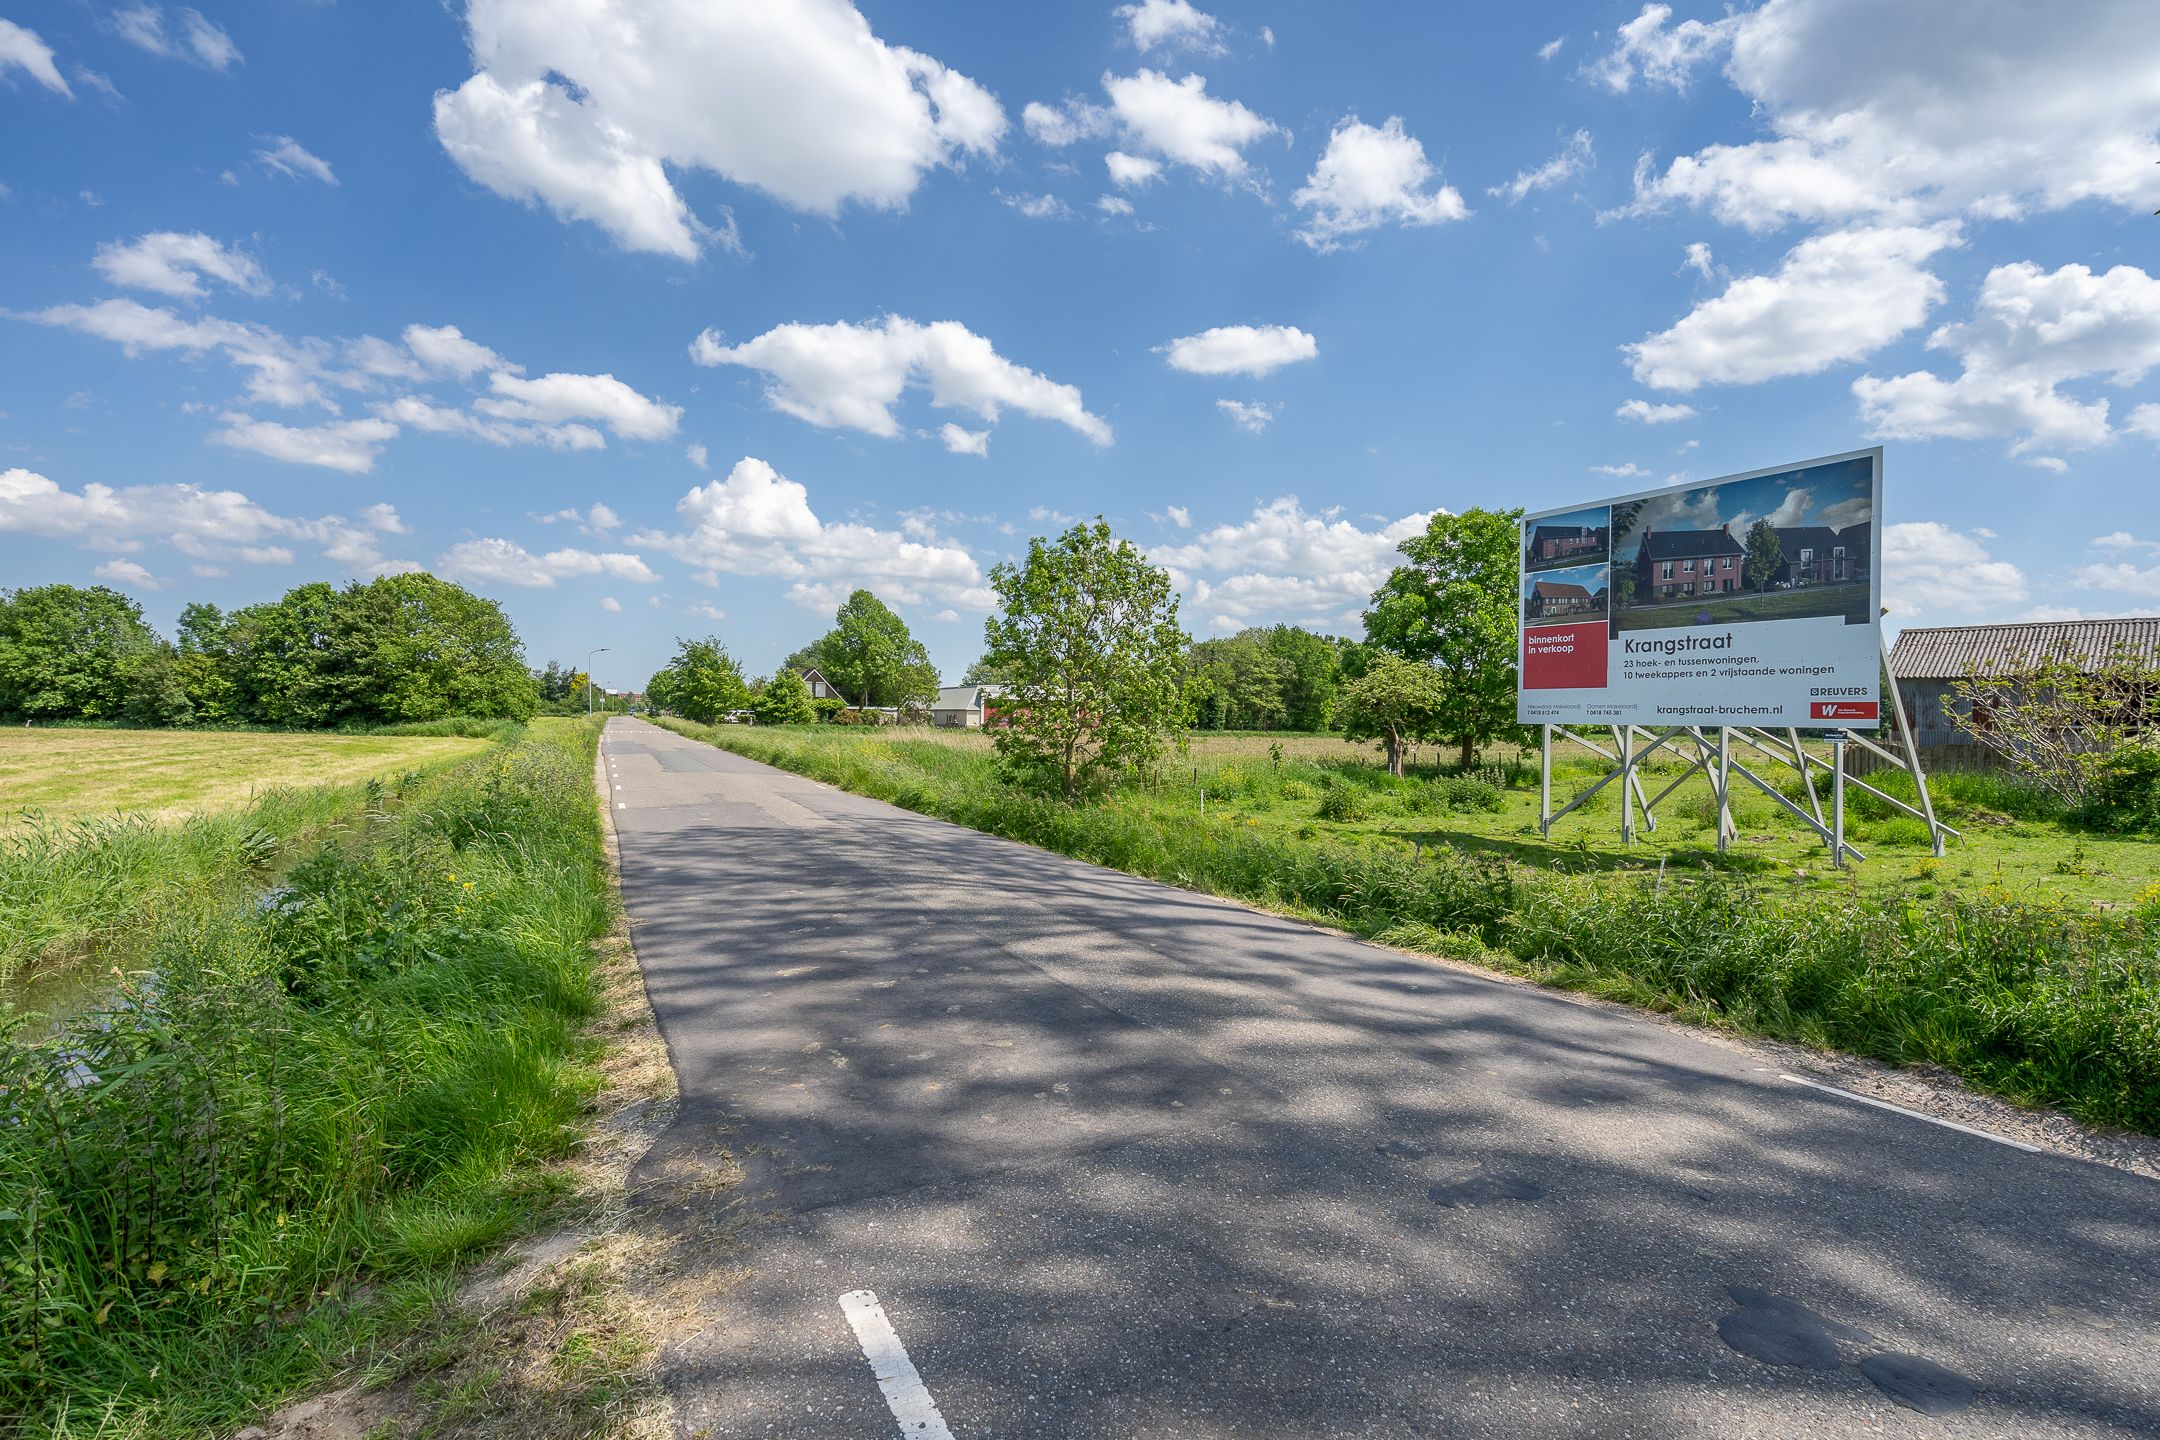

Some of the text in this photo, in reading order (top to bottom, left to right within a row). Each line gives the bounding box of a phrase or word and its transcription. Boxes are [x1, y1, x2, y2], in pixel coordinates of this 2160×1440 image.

[1528, 633, 1575, 645] binnenkort
[1625, 632, 1733, 655] Krangstraat
[1528, 644, 1574, 654] in verkoop
[1623, 660, 1634, 668] 23
[1635, 658, 1662, 668] hoek-
[1664, 659, 1676, 667] en
[1623, 665, 1835, 680] 10 tweekappers en 2 vrijstaande woningen
[1656, 704, 1783, 716] krangstraat-bruchem.nl
[1821, 704, 1838, 717] W
